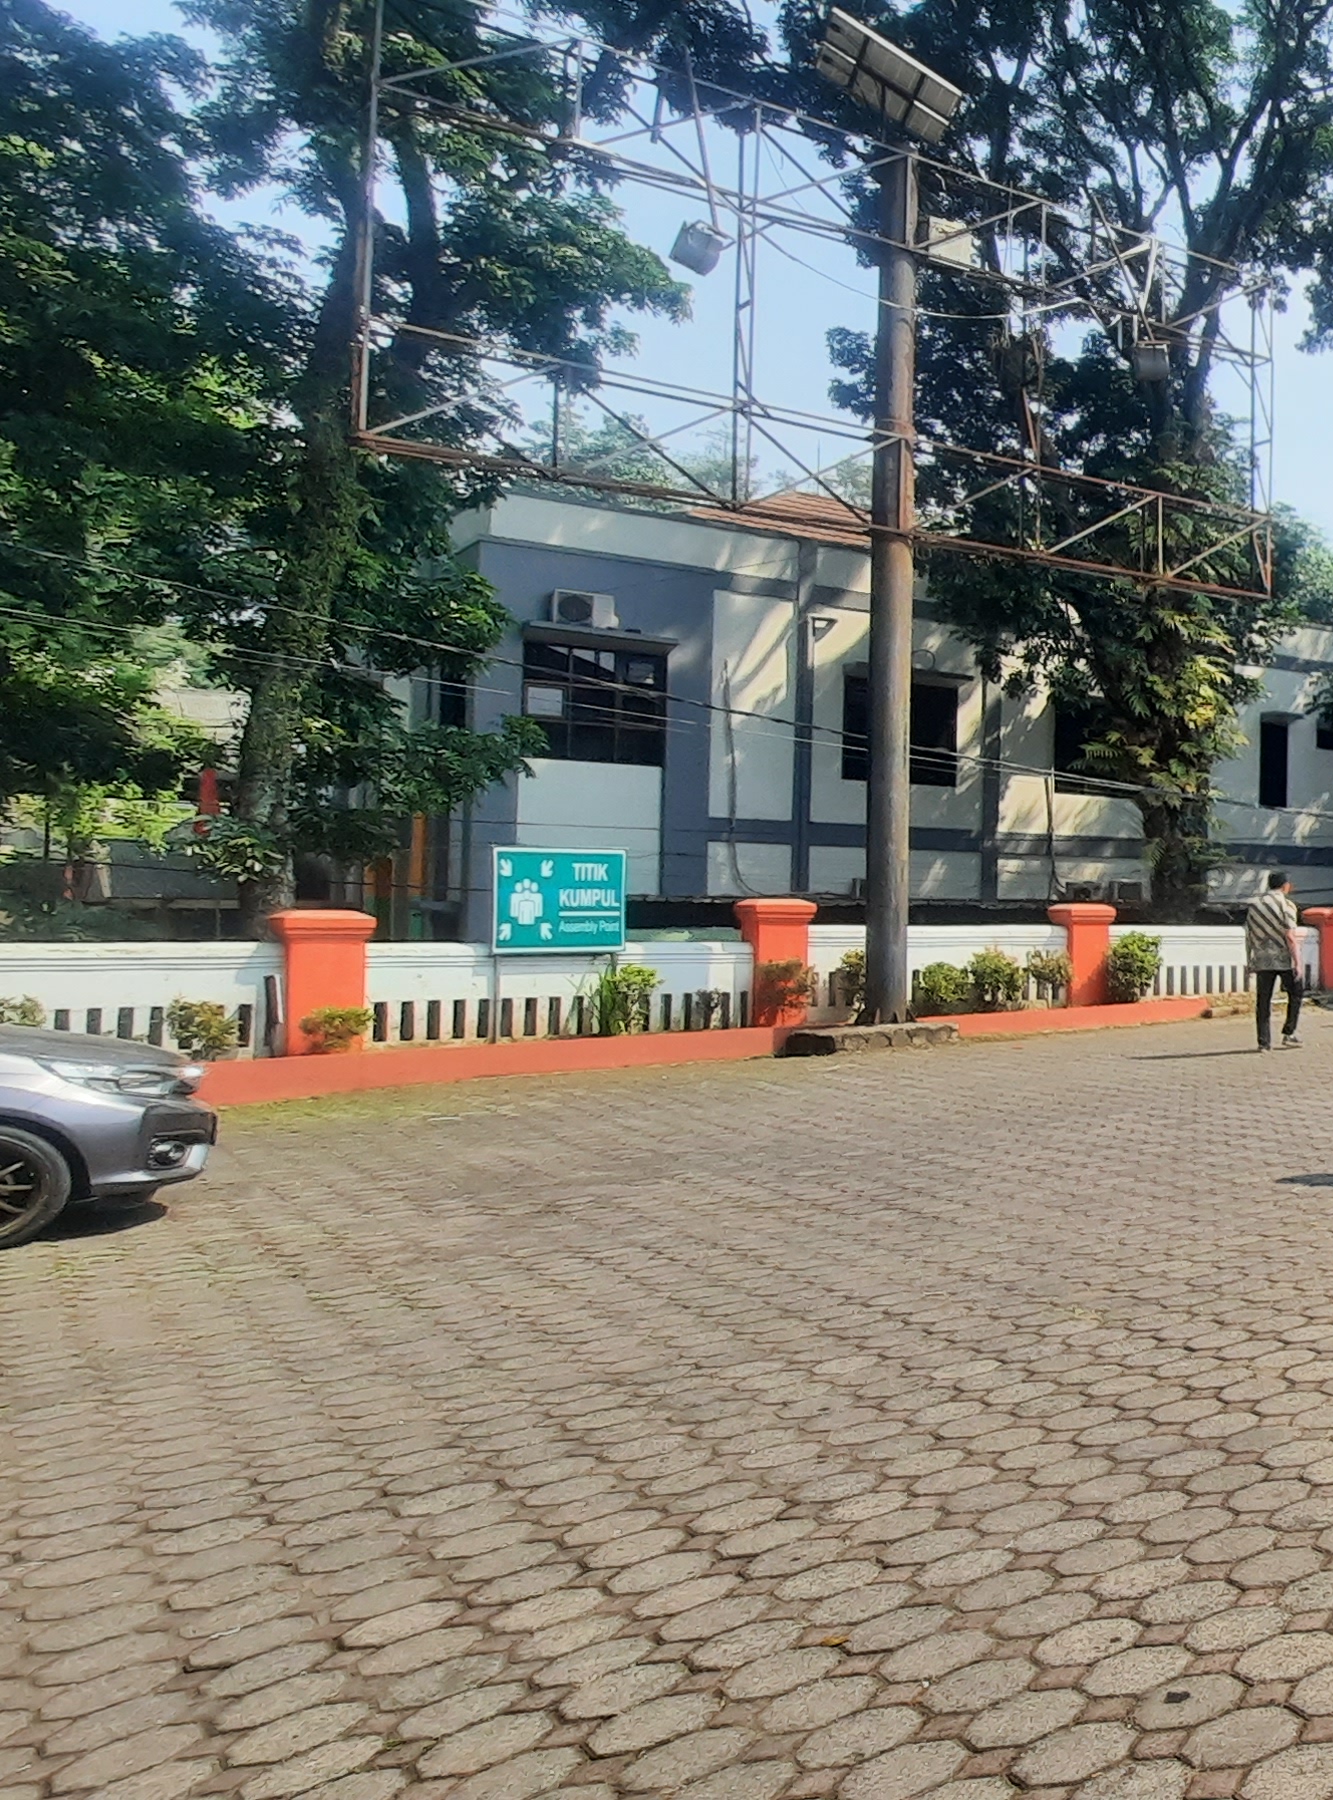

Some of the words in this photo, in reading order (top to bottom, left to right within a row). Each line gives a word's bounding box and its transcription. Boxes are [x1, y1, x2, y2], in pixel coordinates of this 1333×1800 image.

[572, 863, 609, 882] TITIK
[559, 888, 620, 907] KUMPUL
[559, 921, 598, 935] Assembly
[599, 920, 620, 933] Point
